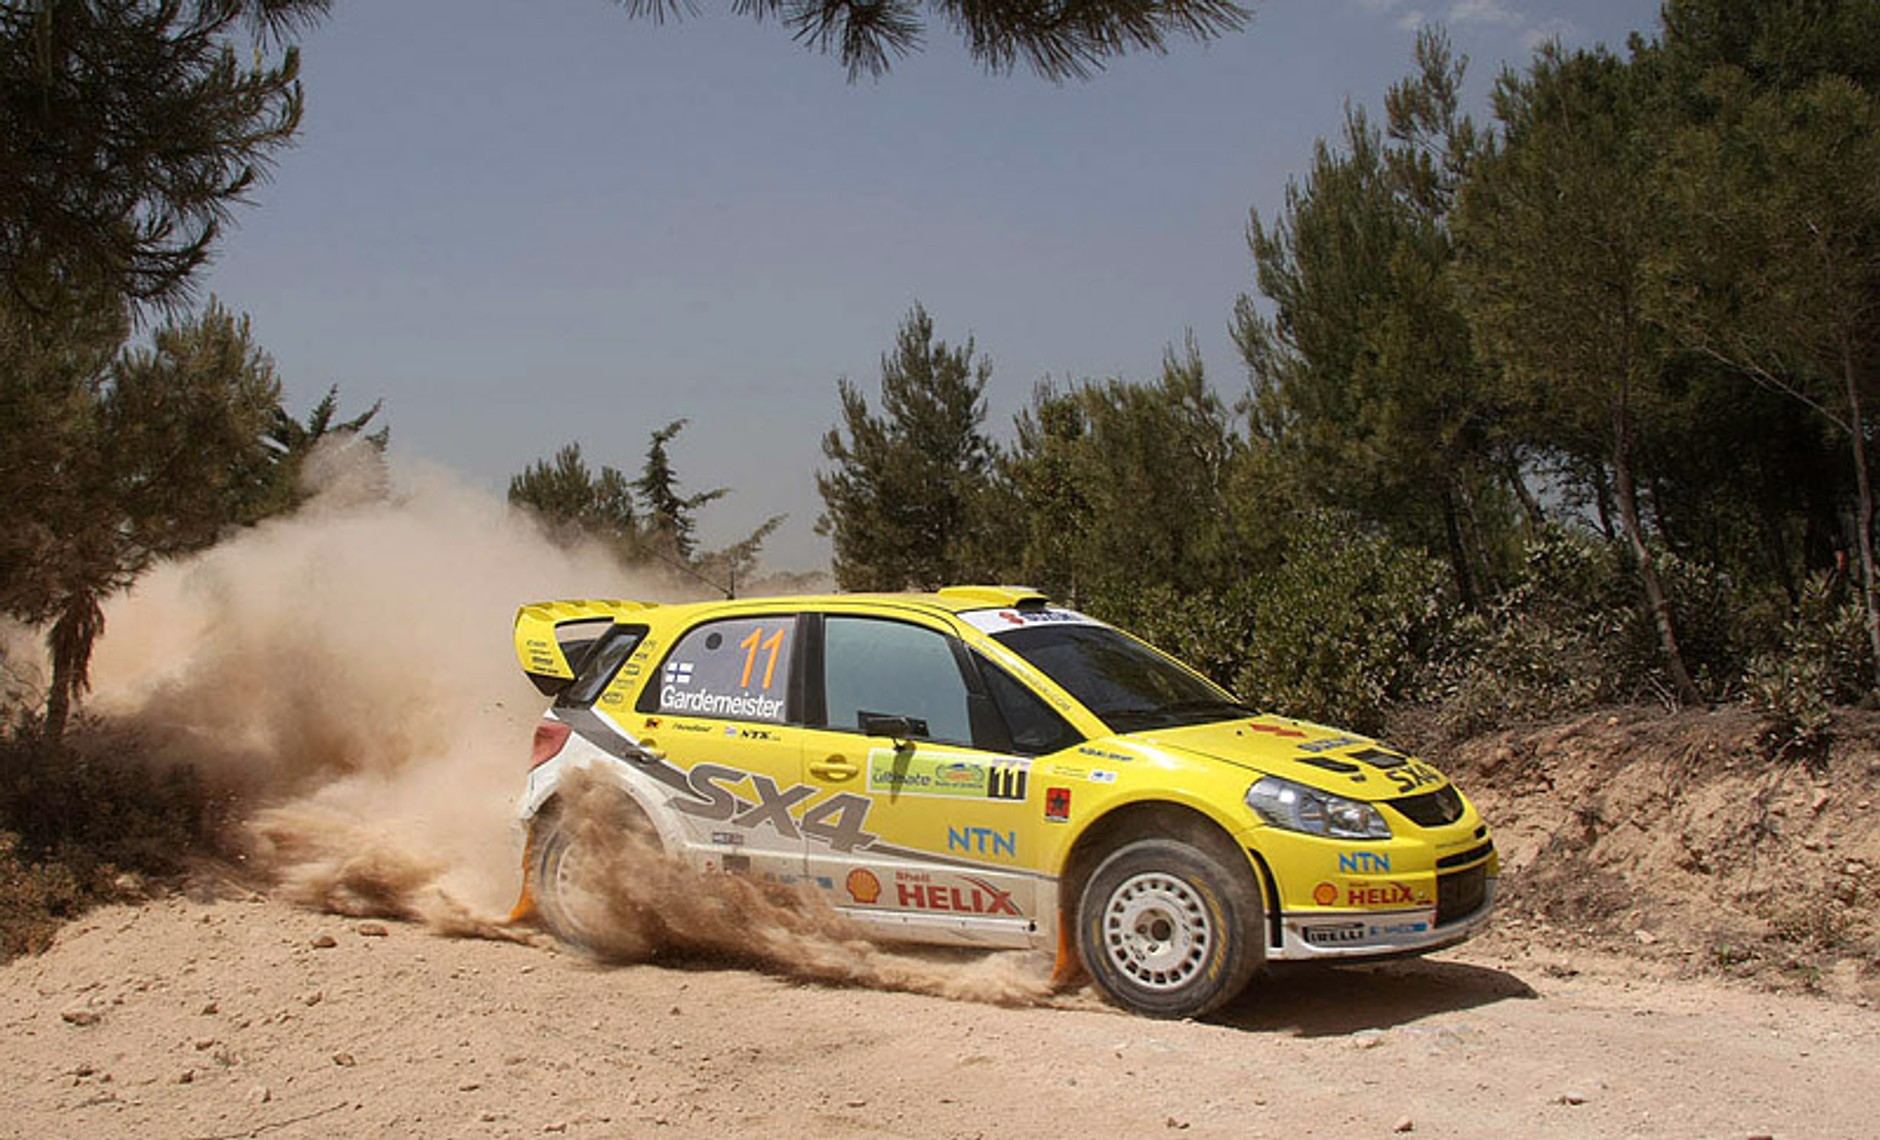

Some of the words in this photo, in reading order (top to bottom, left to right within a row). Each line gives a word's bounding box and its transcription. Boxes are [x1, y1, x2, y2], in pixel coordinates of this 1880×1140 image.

[740, 627, 785, 689] 11
[660, 685, 784, 718] Gardemeister
[994, 762, 1023, 798] 11
[1386, 763, 1441, 793] SX4
[670, 762, 881, 853] SX4
[948, 826, 1016, 856] NTN
[895, 871, 932, 883] Shell
[1339, 853, 1391, 873] NTN
[896, 878, 1021, 915] HELIX
[1348, 885, 1415, 905] HELIX
[1302, 923, 1365, 944] PIRELLI
